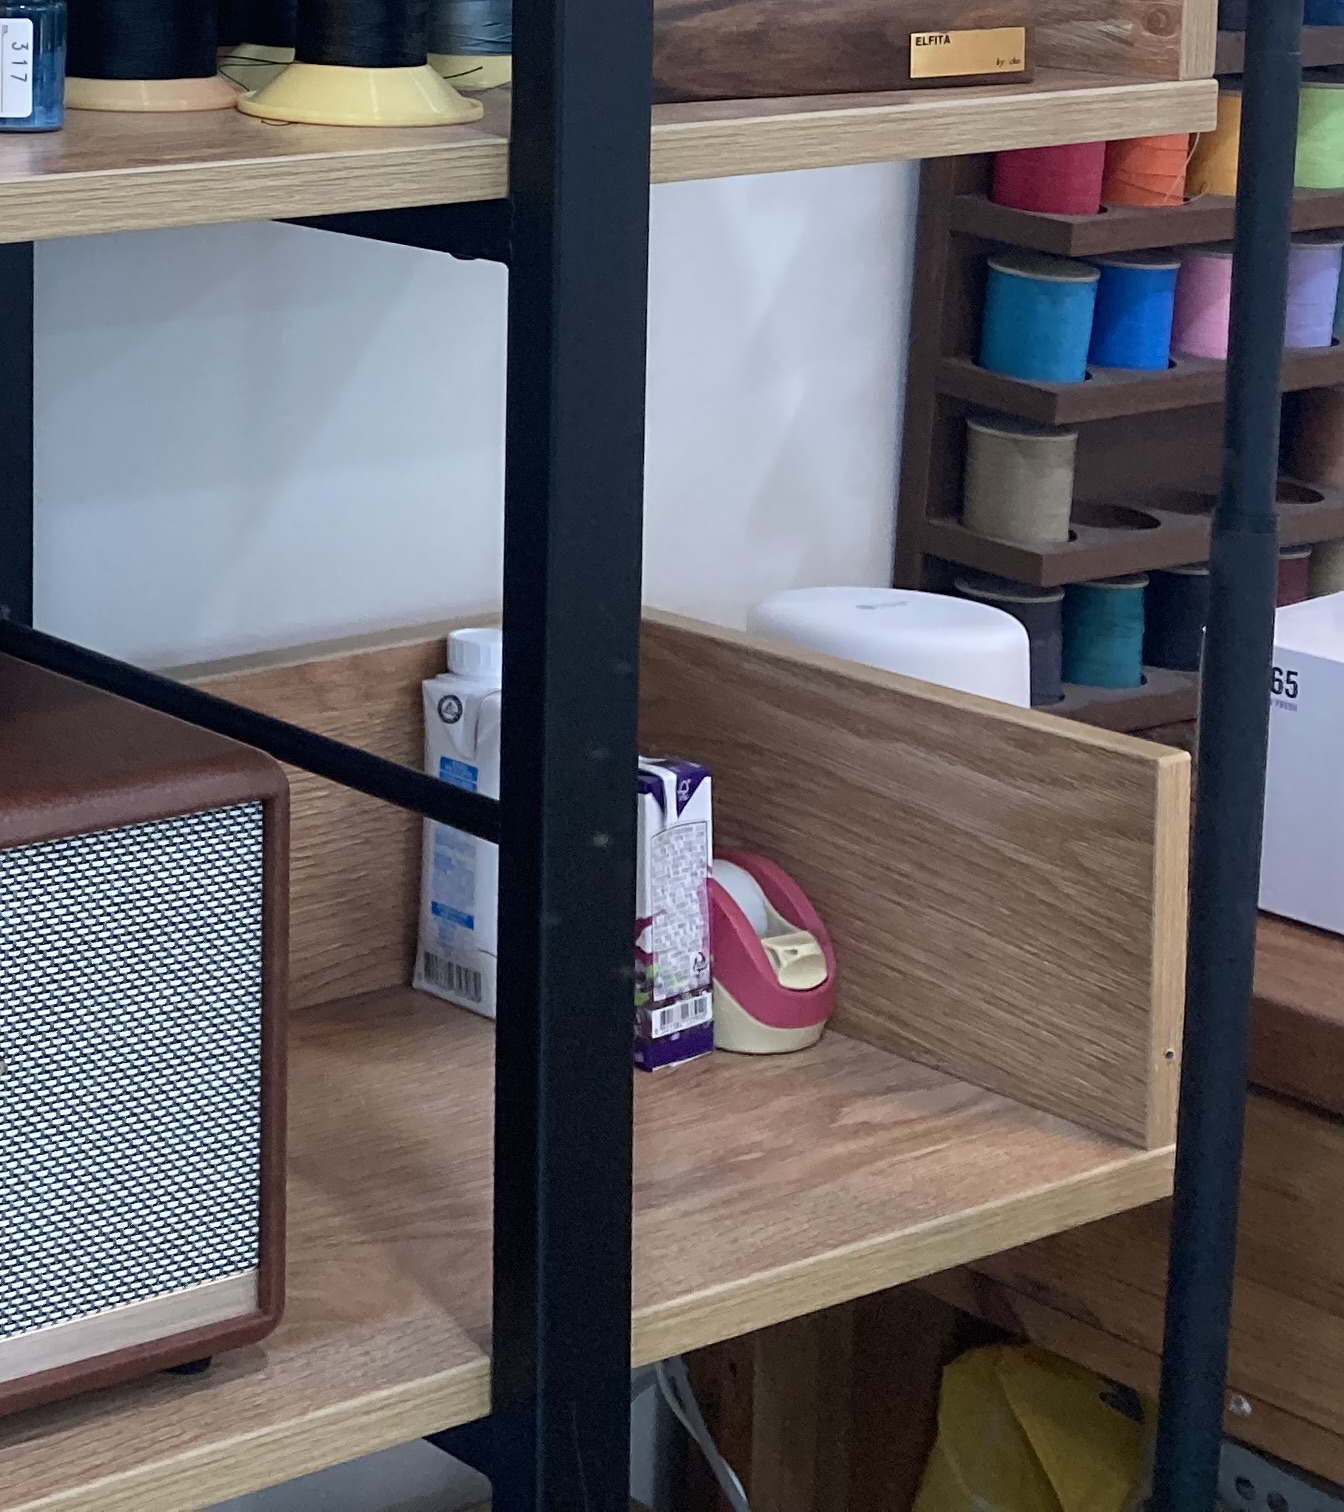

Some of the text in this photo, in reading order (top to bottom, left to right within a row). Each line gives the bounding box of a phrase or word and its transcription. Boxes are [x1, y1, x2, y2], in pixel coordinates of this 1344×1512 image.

[915, 34, 951, 47] ELFITA
[11, 41, 29, 82] 317
[1271, 667, 1298, 699] 65
